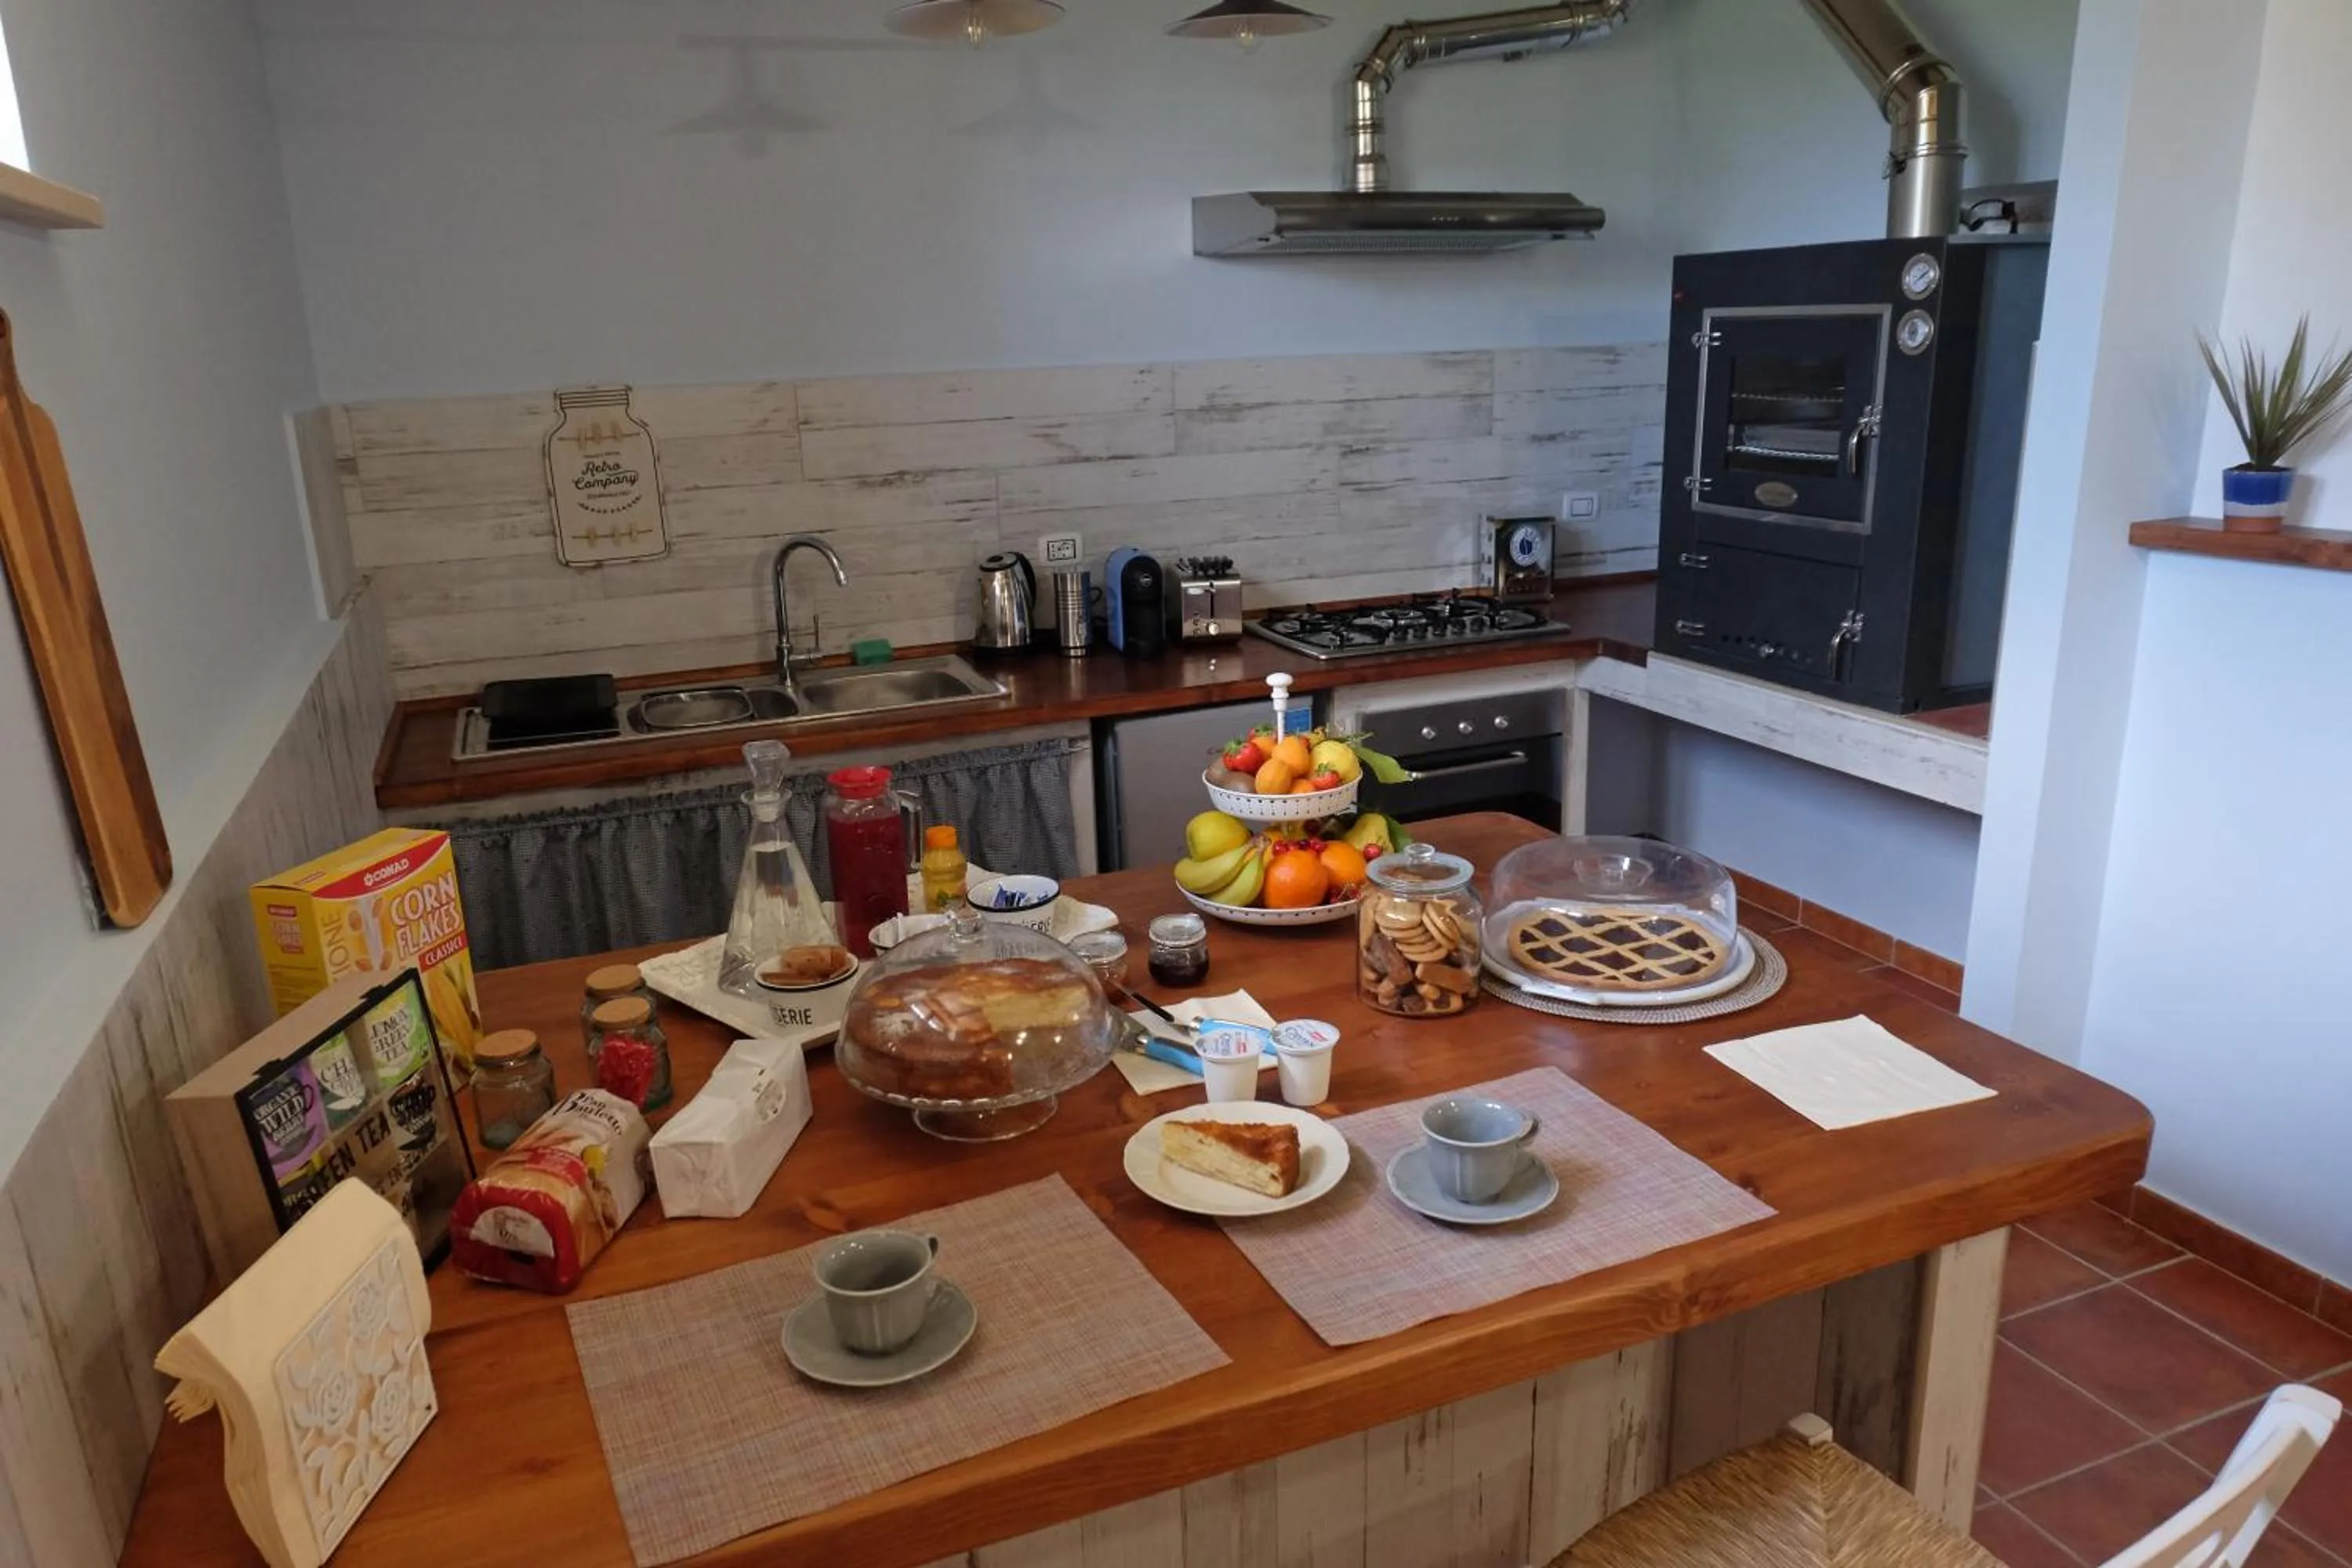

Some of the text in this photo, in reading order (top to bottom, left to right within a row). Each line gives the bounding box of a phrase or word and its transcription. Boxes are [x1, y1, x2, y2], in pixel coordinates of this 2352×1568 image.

[573, 470, 639, 490] Company
[581, 460, 622, 477] Retro
[372, 858, 410, 882] CONAD
[391, 871, 456, 927] CORN
[396, 901, 461, 961] FLAKES
[772, 1007, 813, 1025] ERIE
[260, 1095, 304, 1134] WILD
[355, 1111, 391, 1155] TEA
